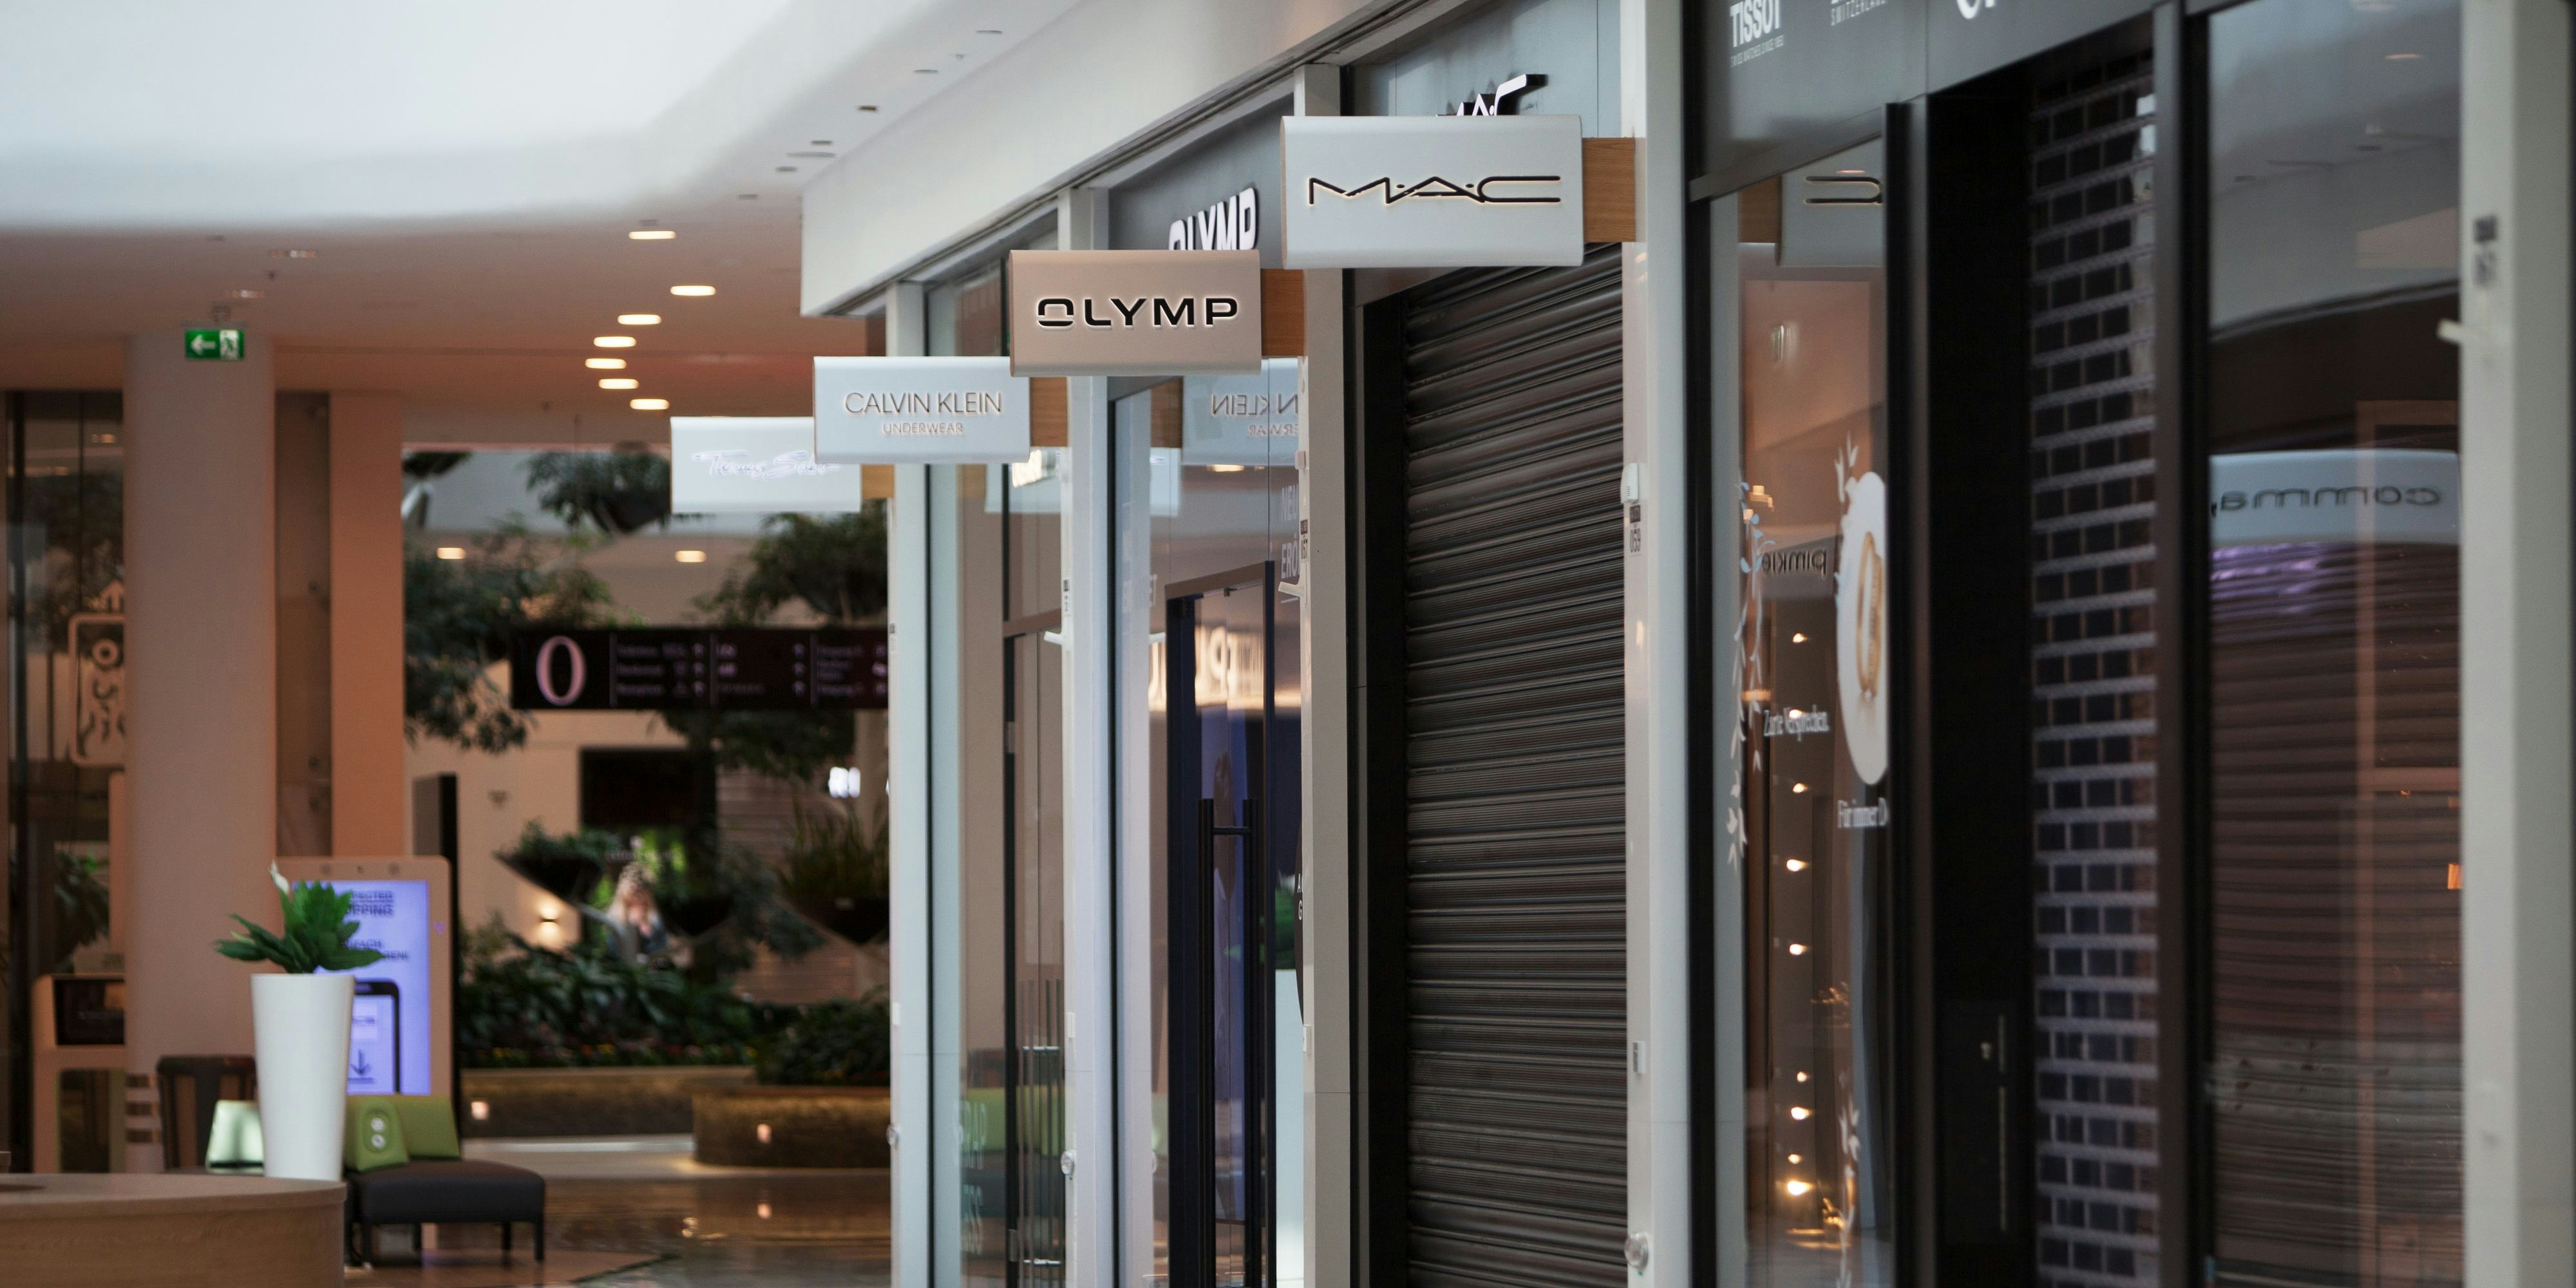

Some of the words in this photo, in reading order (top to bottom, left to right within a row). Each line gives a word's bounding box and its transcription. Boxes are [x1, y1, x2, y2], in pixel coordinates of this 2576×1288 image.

[1729, 0, 1781, 48] TISSOT
[1037, 296, 1238, 329] OLYMP
[844, 391, 931, 415] CALVIN
[938, 391, 1003, 415] KLEIN
[882, 422, 965, 437] UNDERWEAR
